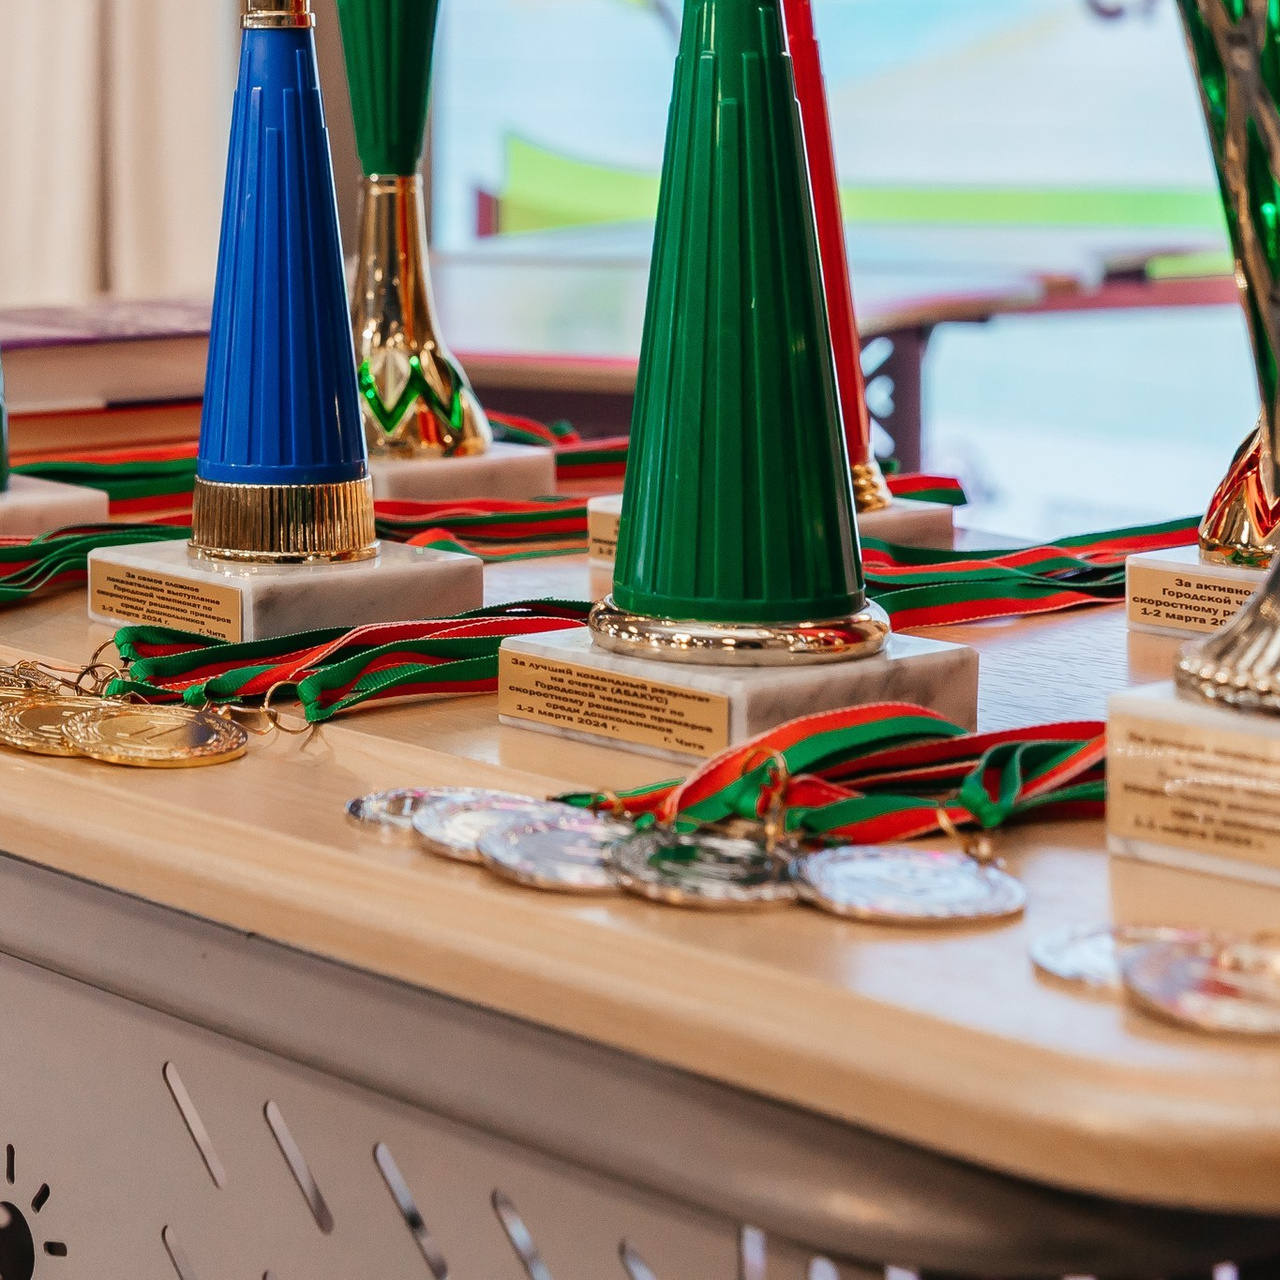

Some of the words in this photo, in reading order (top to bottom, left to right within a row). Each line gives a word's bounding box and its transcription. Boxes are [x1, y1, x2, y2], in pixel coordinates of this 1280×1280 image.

[106, 576, 165, 593] показательное
[167, 589, 220, 605] выступление
[137, 576, 163, 585] самое
[165, 581, 200, 593] сложное
[1175, 578, 1191, 588] За
[96, 589, 147, 605] скоростному
[149, 600, 188, 614] решению
[190, 610, 232, 624] примеров
[113, 584, 154, 598] Городской
[156, 595, 201, 608] чемпионат
[1132, 596, 1219, 617] скоростному
[1162, 588, 1231, 605] Городской
[101, 604, 114, 613] 1-2
[115, 609, 140, 619] марта
[141, 614, 163, 624] 2024
[120, 602, 144, 612] среди
[146, 608, 205, 626] дошкольников
[1141, 607, 1161, 618] 1-2
[1165, 612, 1207, 625] марта
[206, 629, 226, 639] Чита
[511, 657, 526, 667] За
[528, 662, 573, 677] лучший
[576, 671, 648, 691] командный
[651, 687, 710, 704] результат
[550, 675, 564, 683] на
[567, 680, 608, 692] счетах
[610, 687, 669, 706] (АБАКУС)
[508, 685, 585, 707] скоростному
[587, 701, 646, 719] решению
[650, 715, 713, 734] примеров
[534, 680, 596, 699] Городской
[599, 695, 667, 714] чемпионат
[670, 709, 684, 718] по
[516, 704, 535, 713] 1-2
[537, 709, 574, 722] марта
[577, 717, 608, 729] 2024
[545, 701, 580, 715] среди
[583, 710, 673, 734] дошкольников
[675, 738, 705, 750] Чита
